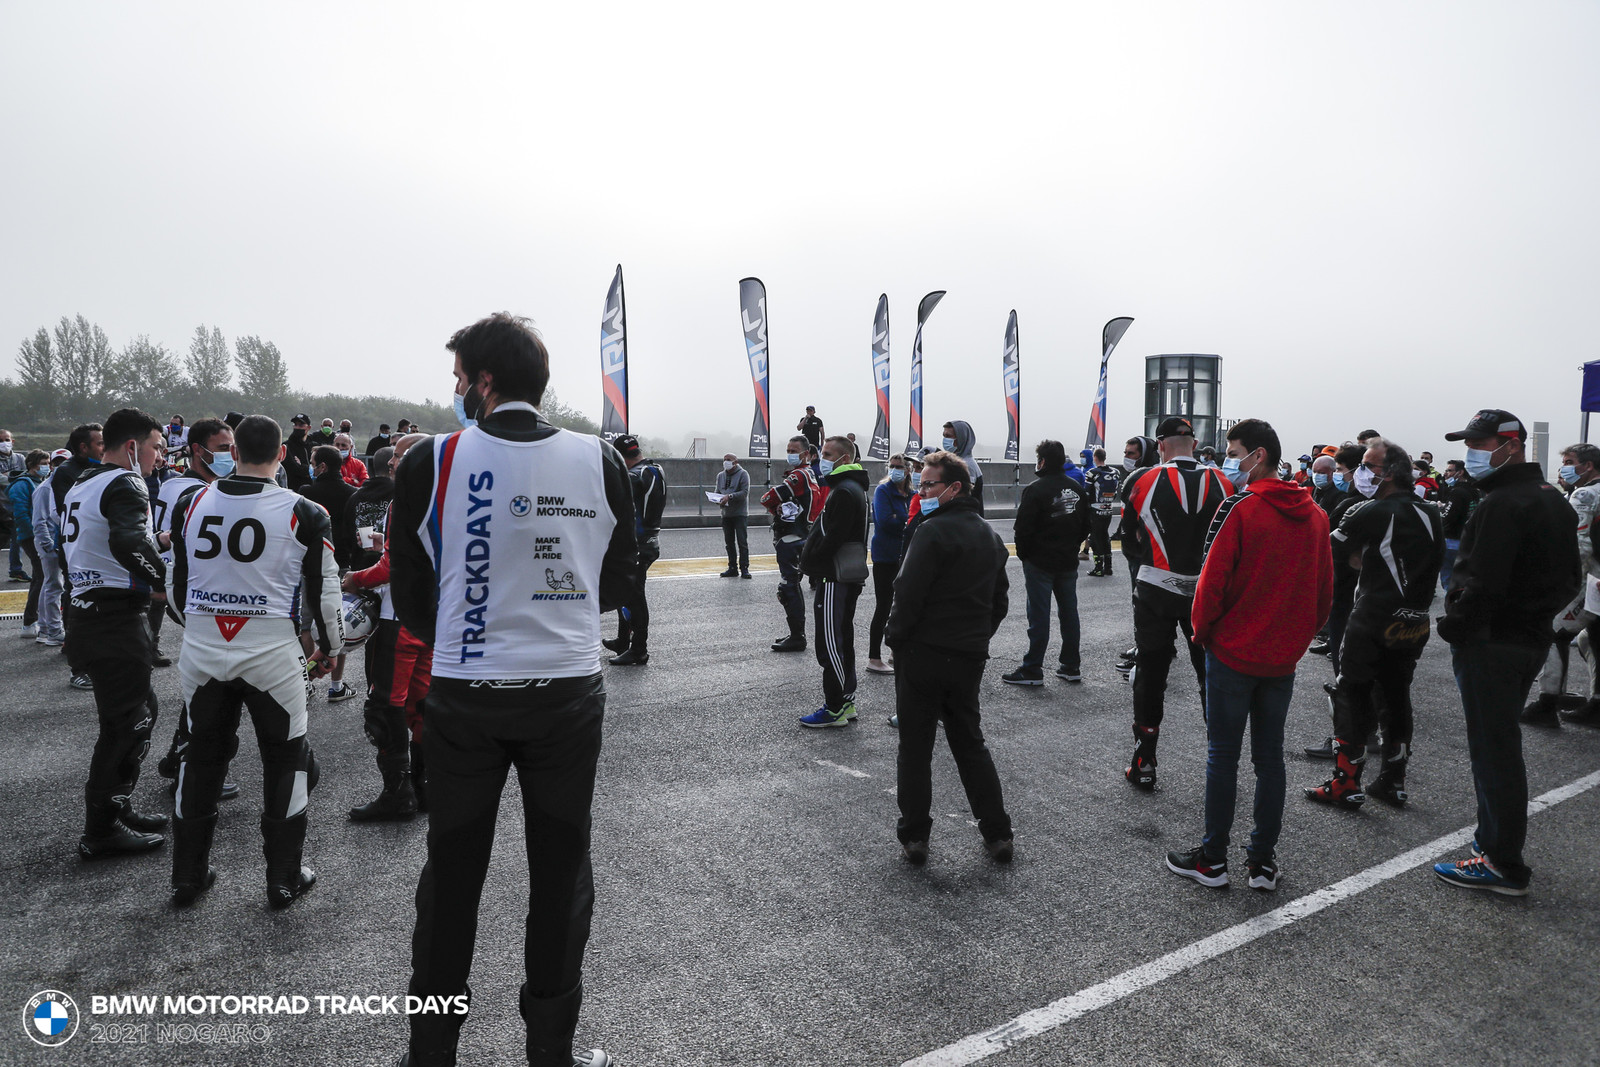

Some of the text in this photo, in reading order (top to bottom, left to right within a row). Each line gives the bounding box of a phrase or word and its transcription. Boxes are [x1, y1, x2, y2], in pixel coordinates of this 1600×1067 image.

[536, 495, 565, 506] BMW
[536, 506, 596, 519] MOTORRAD
[193, 515, 267, 563] 50
[460, 469, 494, 664] TRACKDAYS
[191, 589, 268, 605] TRACKDAYS
[531, 593, 587, 601] MICHELIN
[196, 605, 268, 616] BMW MOTORRAD
